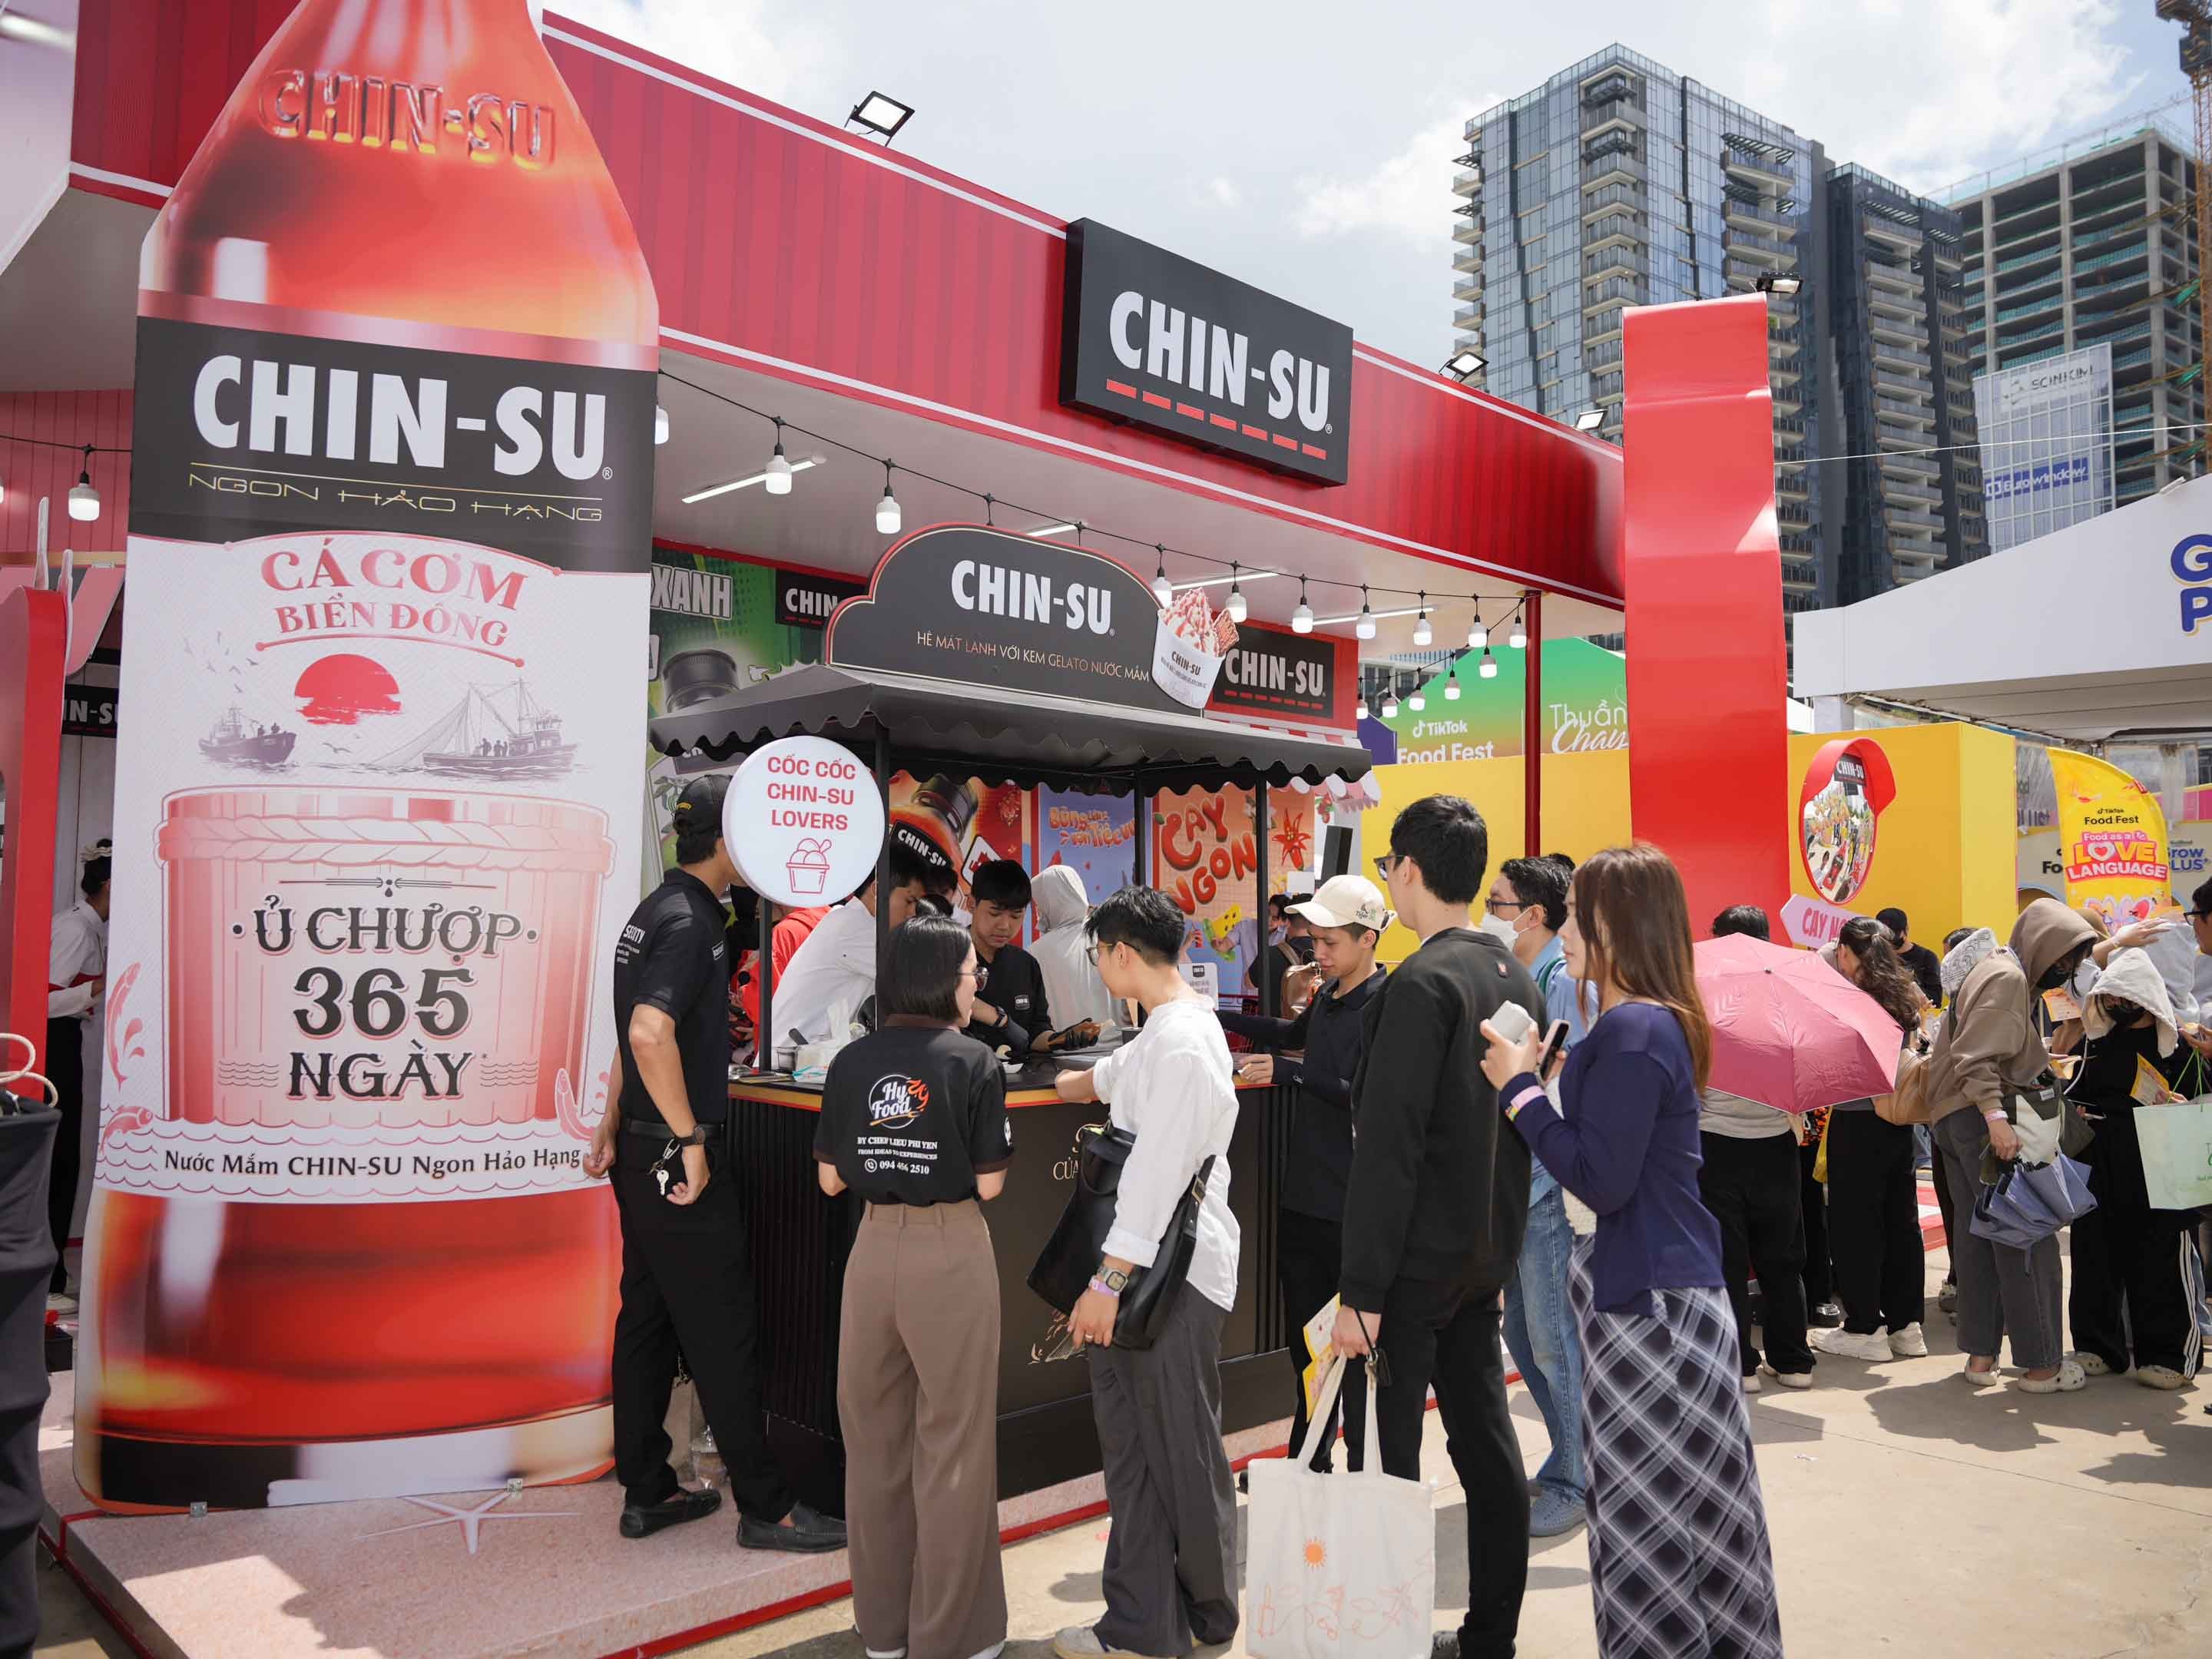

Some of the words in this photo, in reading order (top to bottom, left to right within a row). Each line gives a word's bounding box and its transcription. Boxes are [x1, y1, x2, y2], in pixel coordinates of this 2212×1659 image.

[258, 68, 555, 172] CHIN-SU
[1110, 291, 1330, 432] CHIN-SU
[194, 355, 606, 481] CHIN-SU
[190, 473, 319, 501] NGON
[470, 501, 602, 522] HẠNG
[261, 538, 353, 591] CÁ
[360, 548, 529, 614] CƠM
[952, 560, 1111, 635] CHIN-SU
[389, 602, 510, 647] ĐÔNG
[1023, 648, 1045, 664] KEM
[1048, 653, 1088, 671] GELATO
[1171, 651, 1201, 676] CHIN-SU
[1225, 648, 1323, 697] CHIN-SU
[1426, 719, 1468, 737] TikTok
[1398, 747, 1445, 764] Food
[1451, 741, 1494, 762] Fest
[1836, 760, 1864, 780] CHIN-SU
[767, 783, 854, 806] CHIN-SU
[771, 809, 848, 830] LOVERS
[2084, 816, 2113, 825] Food
[2116, 815, 2139, 823] Fest
[1161, 794, 1229, 871] CAY
[2084, 833, 2108, 841] Food
[2075, 841, 2156, 864] LOVE
[2168, 847, 2204, 859] row
[2068, 861, 2167, 879] LANGUAGE
[1802, 907, 1829, 939] CAY
[293, 966, 475, 1037] 365
[882, 1081, 909, 1103] Hy
[872, 1096, 912, 1120] Food
[856, 1137, 867, 1145] BY
[922, 1141, 938, 1151] YEN
[164, 1149, 216, 1173] Nước
[221, 1152, 279, 1175] Mắm
[289, 1155, 402, 1177] CHIN-SU
[412, 1155, 475, 1180] Ngon
[484, 1151, 526, 1171] Hảo
[879, 1161, 896, 1170] 094
[909, 1162, 930, 1175] 2510
